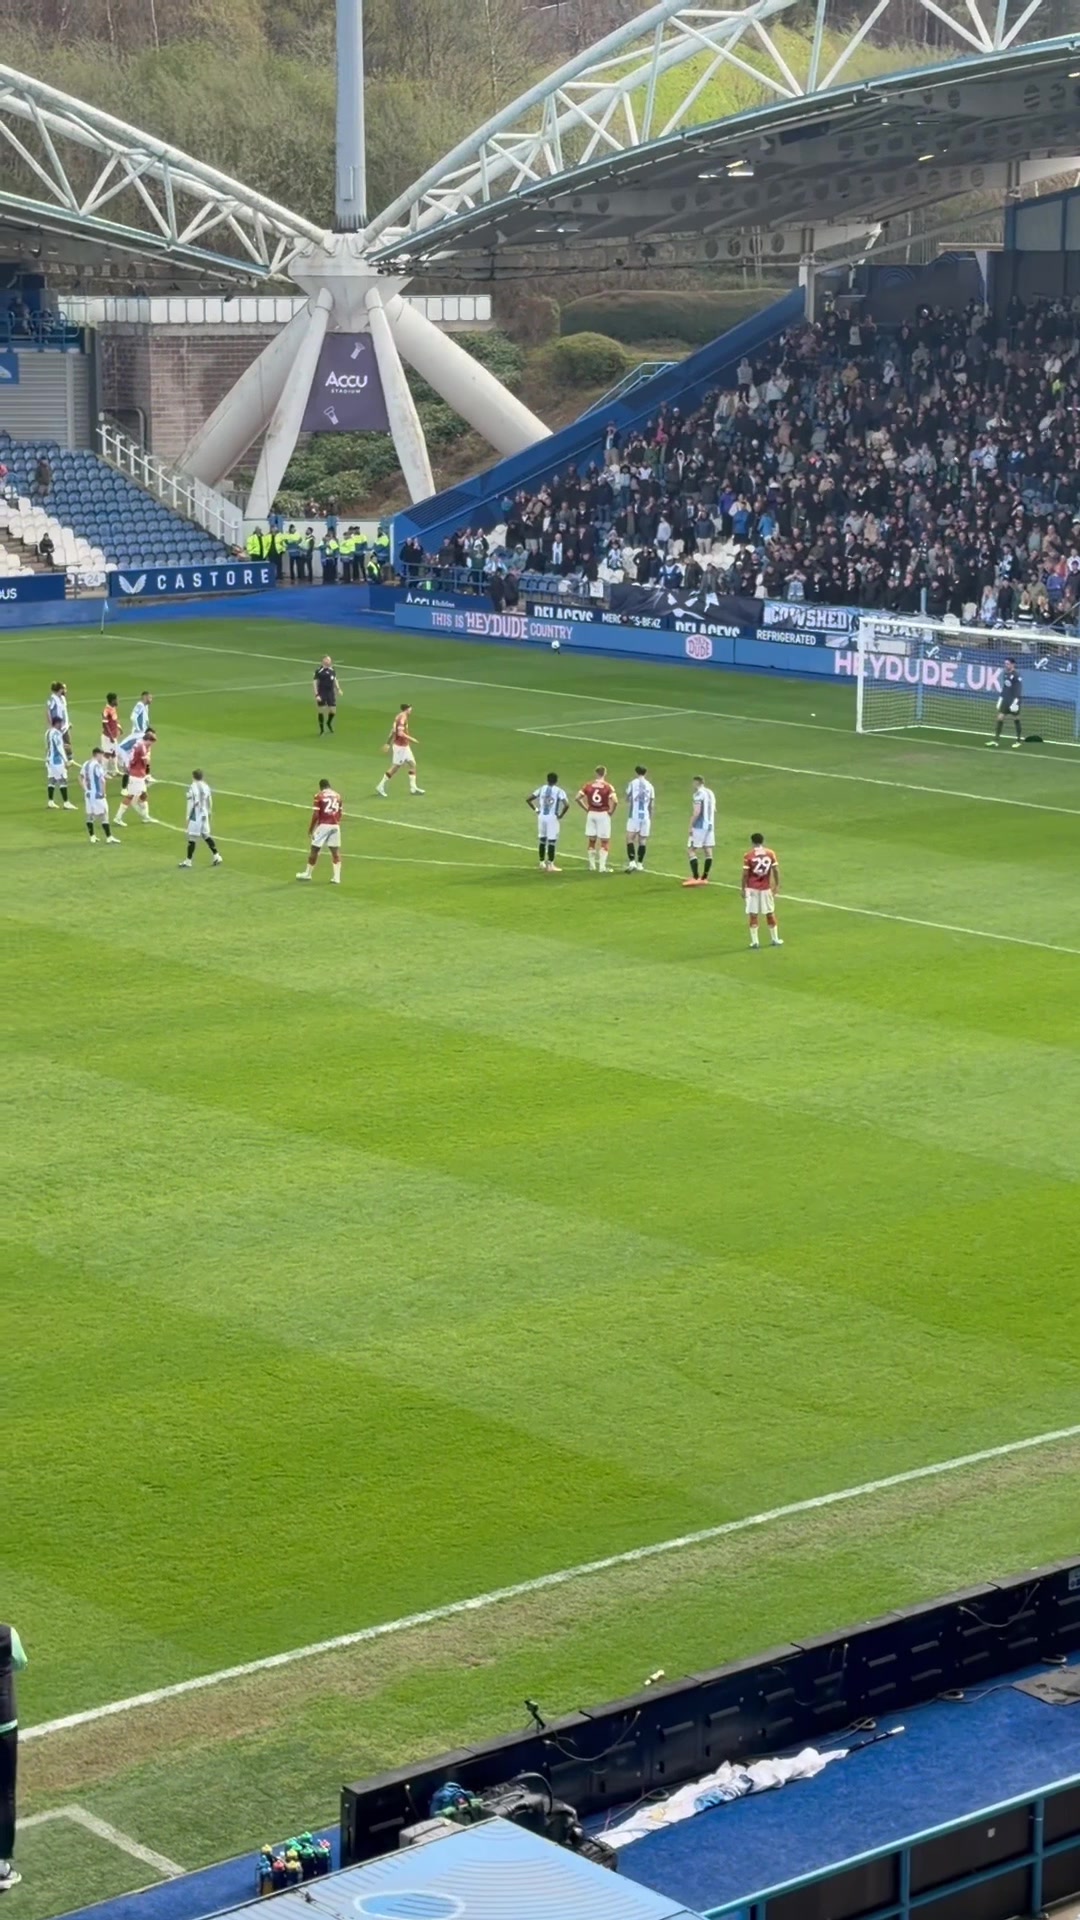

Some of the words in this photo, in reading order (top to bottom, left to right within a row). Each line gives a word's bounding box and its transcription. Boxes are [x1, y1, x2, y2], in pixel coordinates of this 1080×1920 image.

[325, 370, 368, 388] ACCU
[157, 568, 269, 590] CASTORE
[432, 612, 452, 627] THIS
[455, 614, 464, 628] IS
[465, 612, 529, 639] HEYDUDE
[530, 622, 574, 640] COUNTRY
[756, 629, 816, 646] REFRIGERATED
[592, 789, 602, 803] 6
[323, 798, 339, 813] 24
[752, 856, 772, 875] 29
